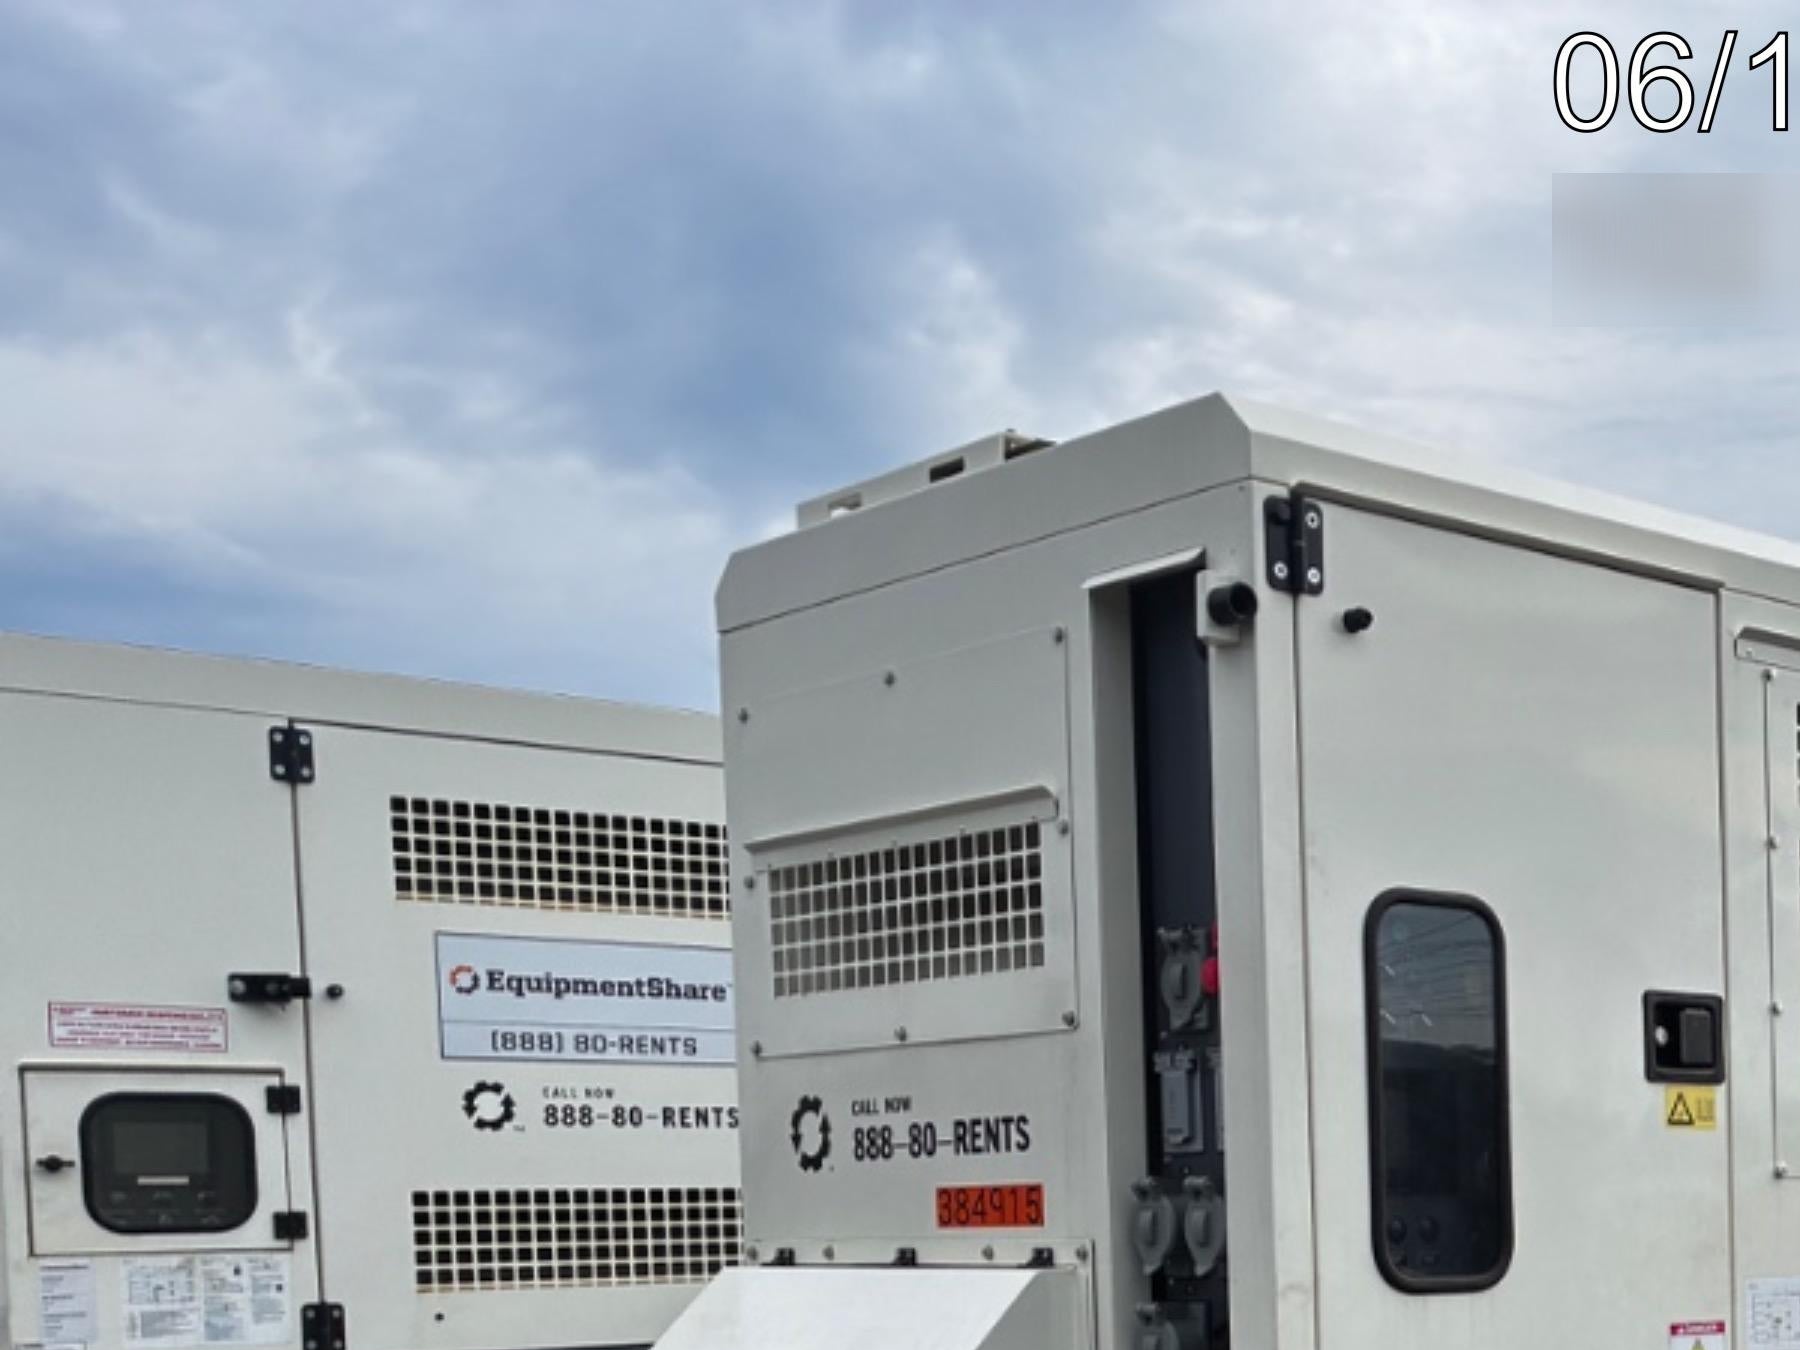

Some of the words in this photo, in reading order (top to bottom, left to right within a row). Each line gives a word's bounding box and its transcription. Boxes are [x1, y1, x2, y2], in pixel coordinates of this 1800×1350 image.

[485, 968, 728, 1002] EquipmentShare
[574, 1033, 697, 1057] 80-RENTS
[543, 1087, 578, 1099] CALL
[585, 1088, 615, 1100] NOW
[851, 1100, 880, 1115] CALL
[884, 1097, 912, 1113] NOW
[543, 1105, 740, 1130] 888-80-RENTS
[853, 1114, 1031, 1161] 888-80-RENTS
[938, 1188, 1043, 1226] 384915
